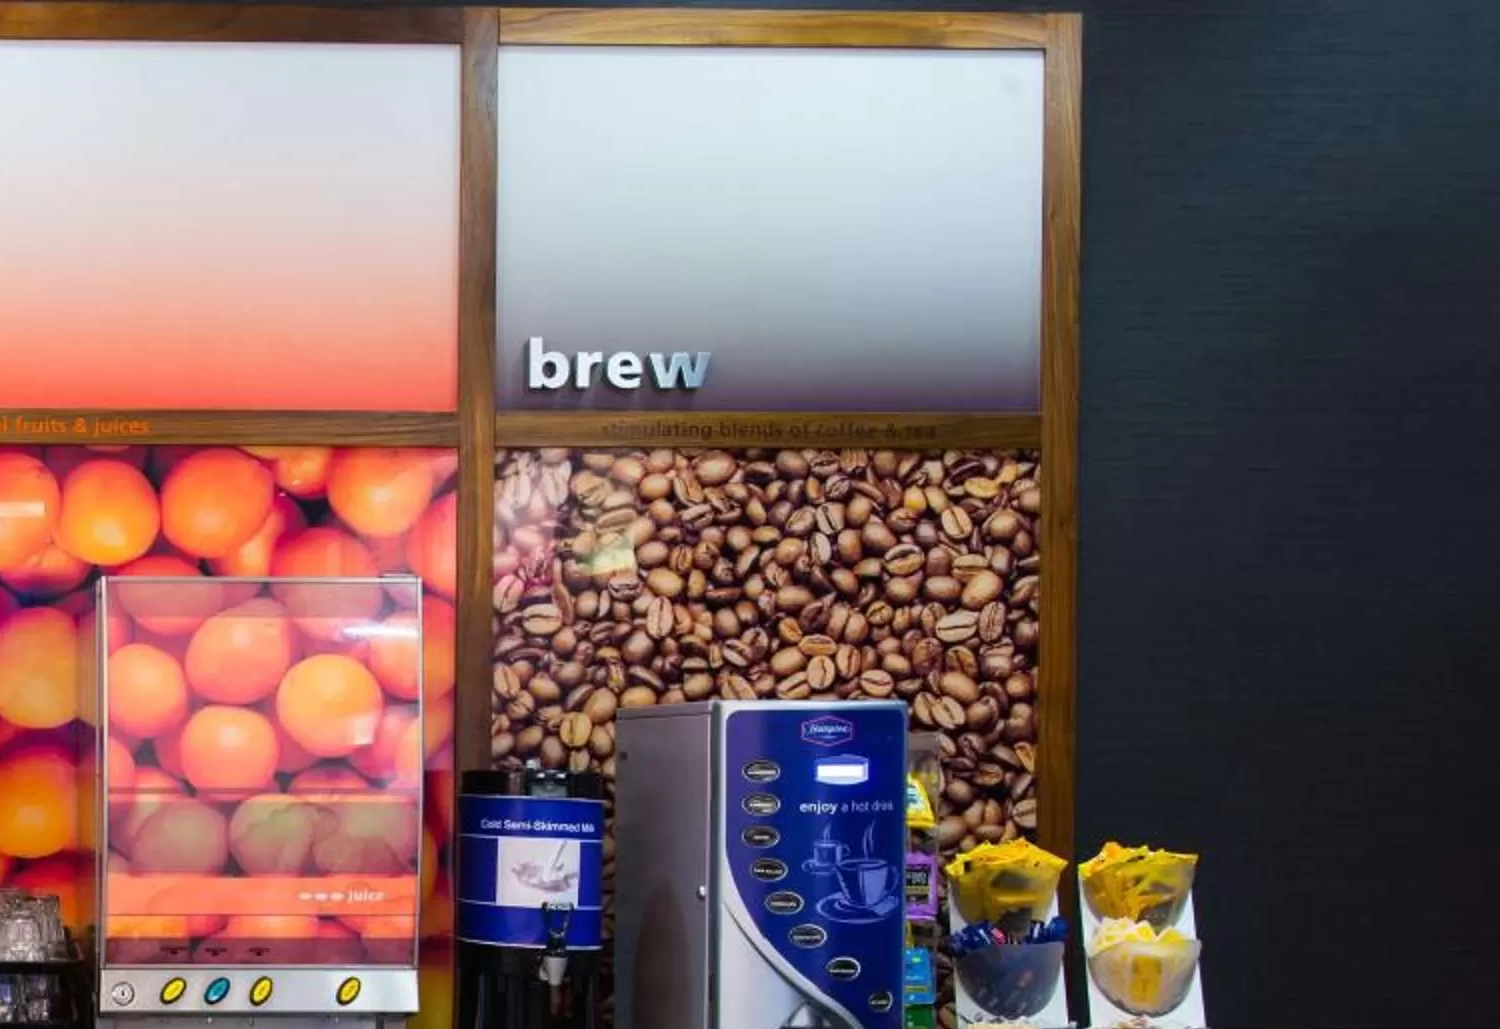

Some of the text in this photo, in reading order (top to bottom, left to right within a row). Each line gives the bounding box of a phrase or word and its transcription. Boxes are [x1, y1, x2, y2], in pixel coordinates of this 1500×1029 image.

[526, 336, 712, 390] brew
[16, 415, 66, 433] fruits
[72, 416, 87, 433] &
[93, 415, 149, 436] juices
[719, 421, 782, 439] blends
[800, 800, 838, 815] enjoy
[851, 800, 869, 812] hot
[347, 888, 385, 903] juice
